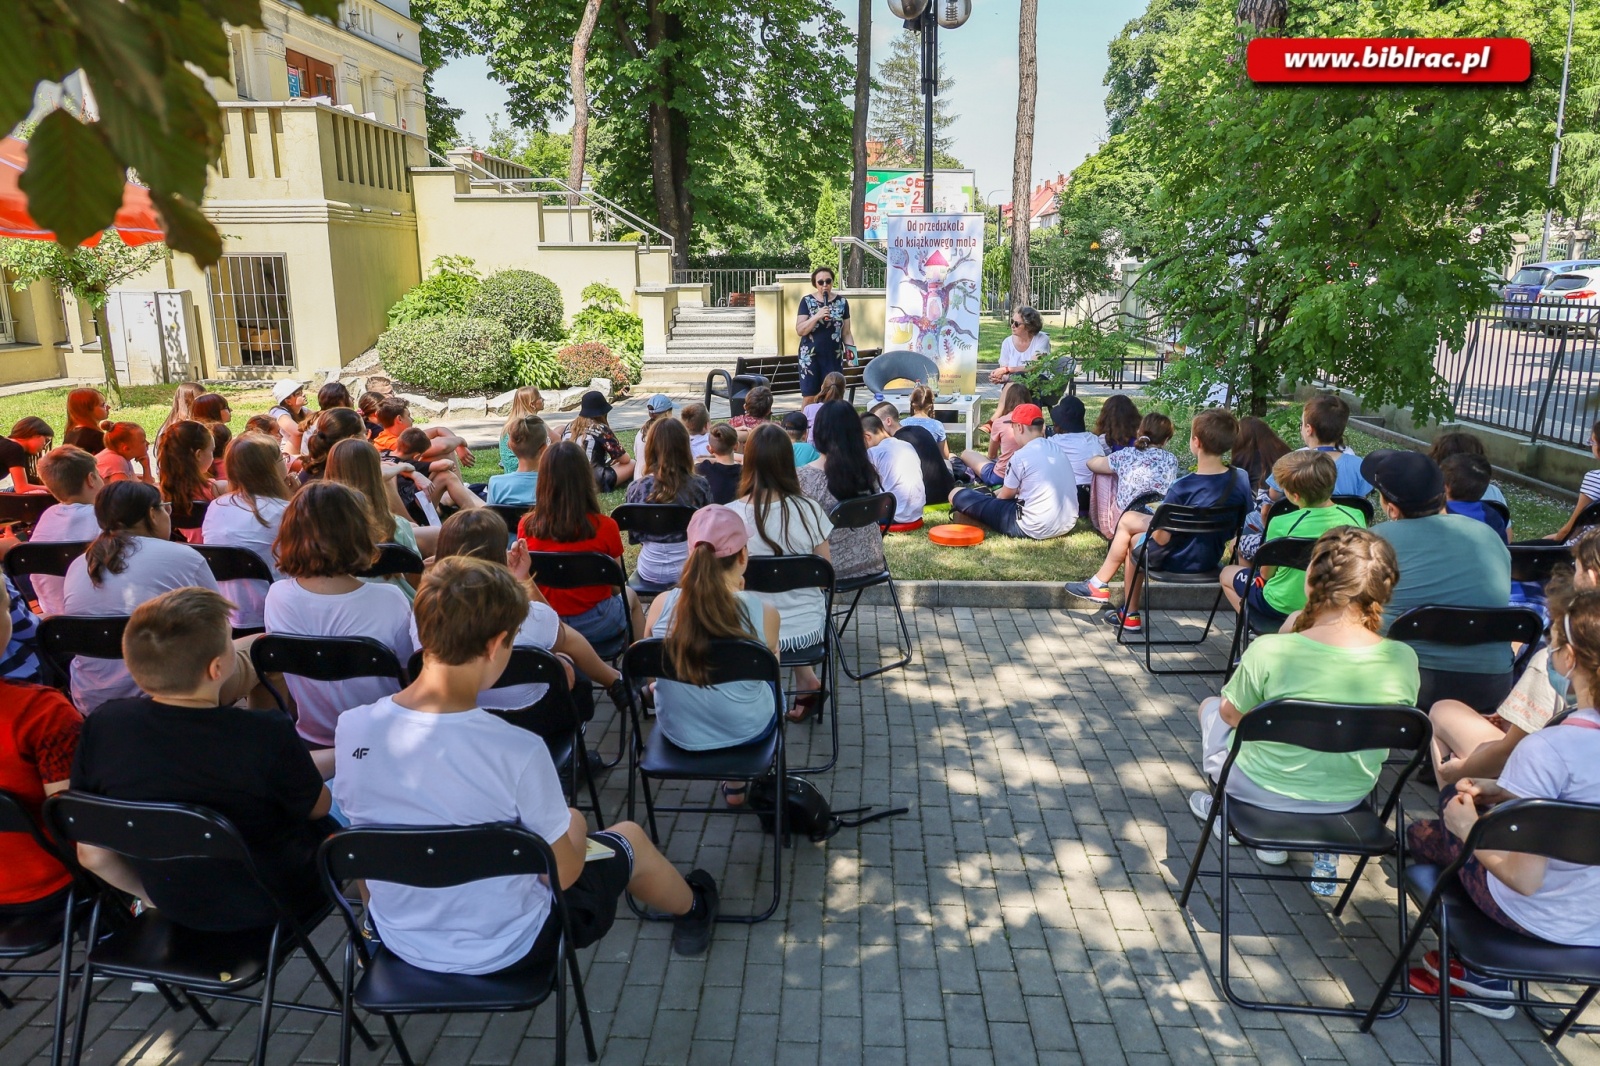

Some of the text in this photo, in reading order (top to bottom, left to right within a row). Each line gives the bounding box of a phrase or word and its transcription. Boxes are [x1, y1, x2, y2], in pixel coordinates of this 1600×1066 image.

[907, 220, 964, 233] Od przedszkola
[894, 236, 977, 249] do książkowego mola
[352, 747, 370, 760] 4F
